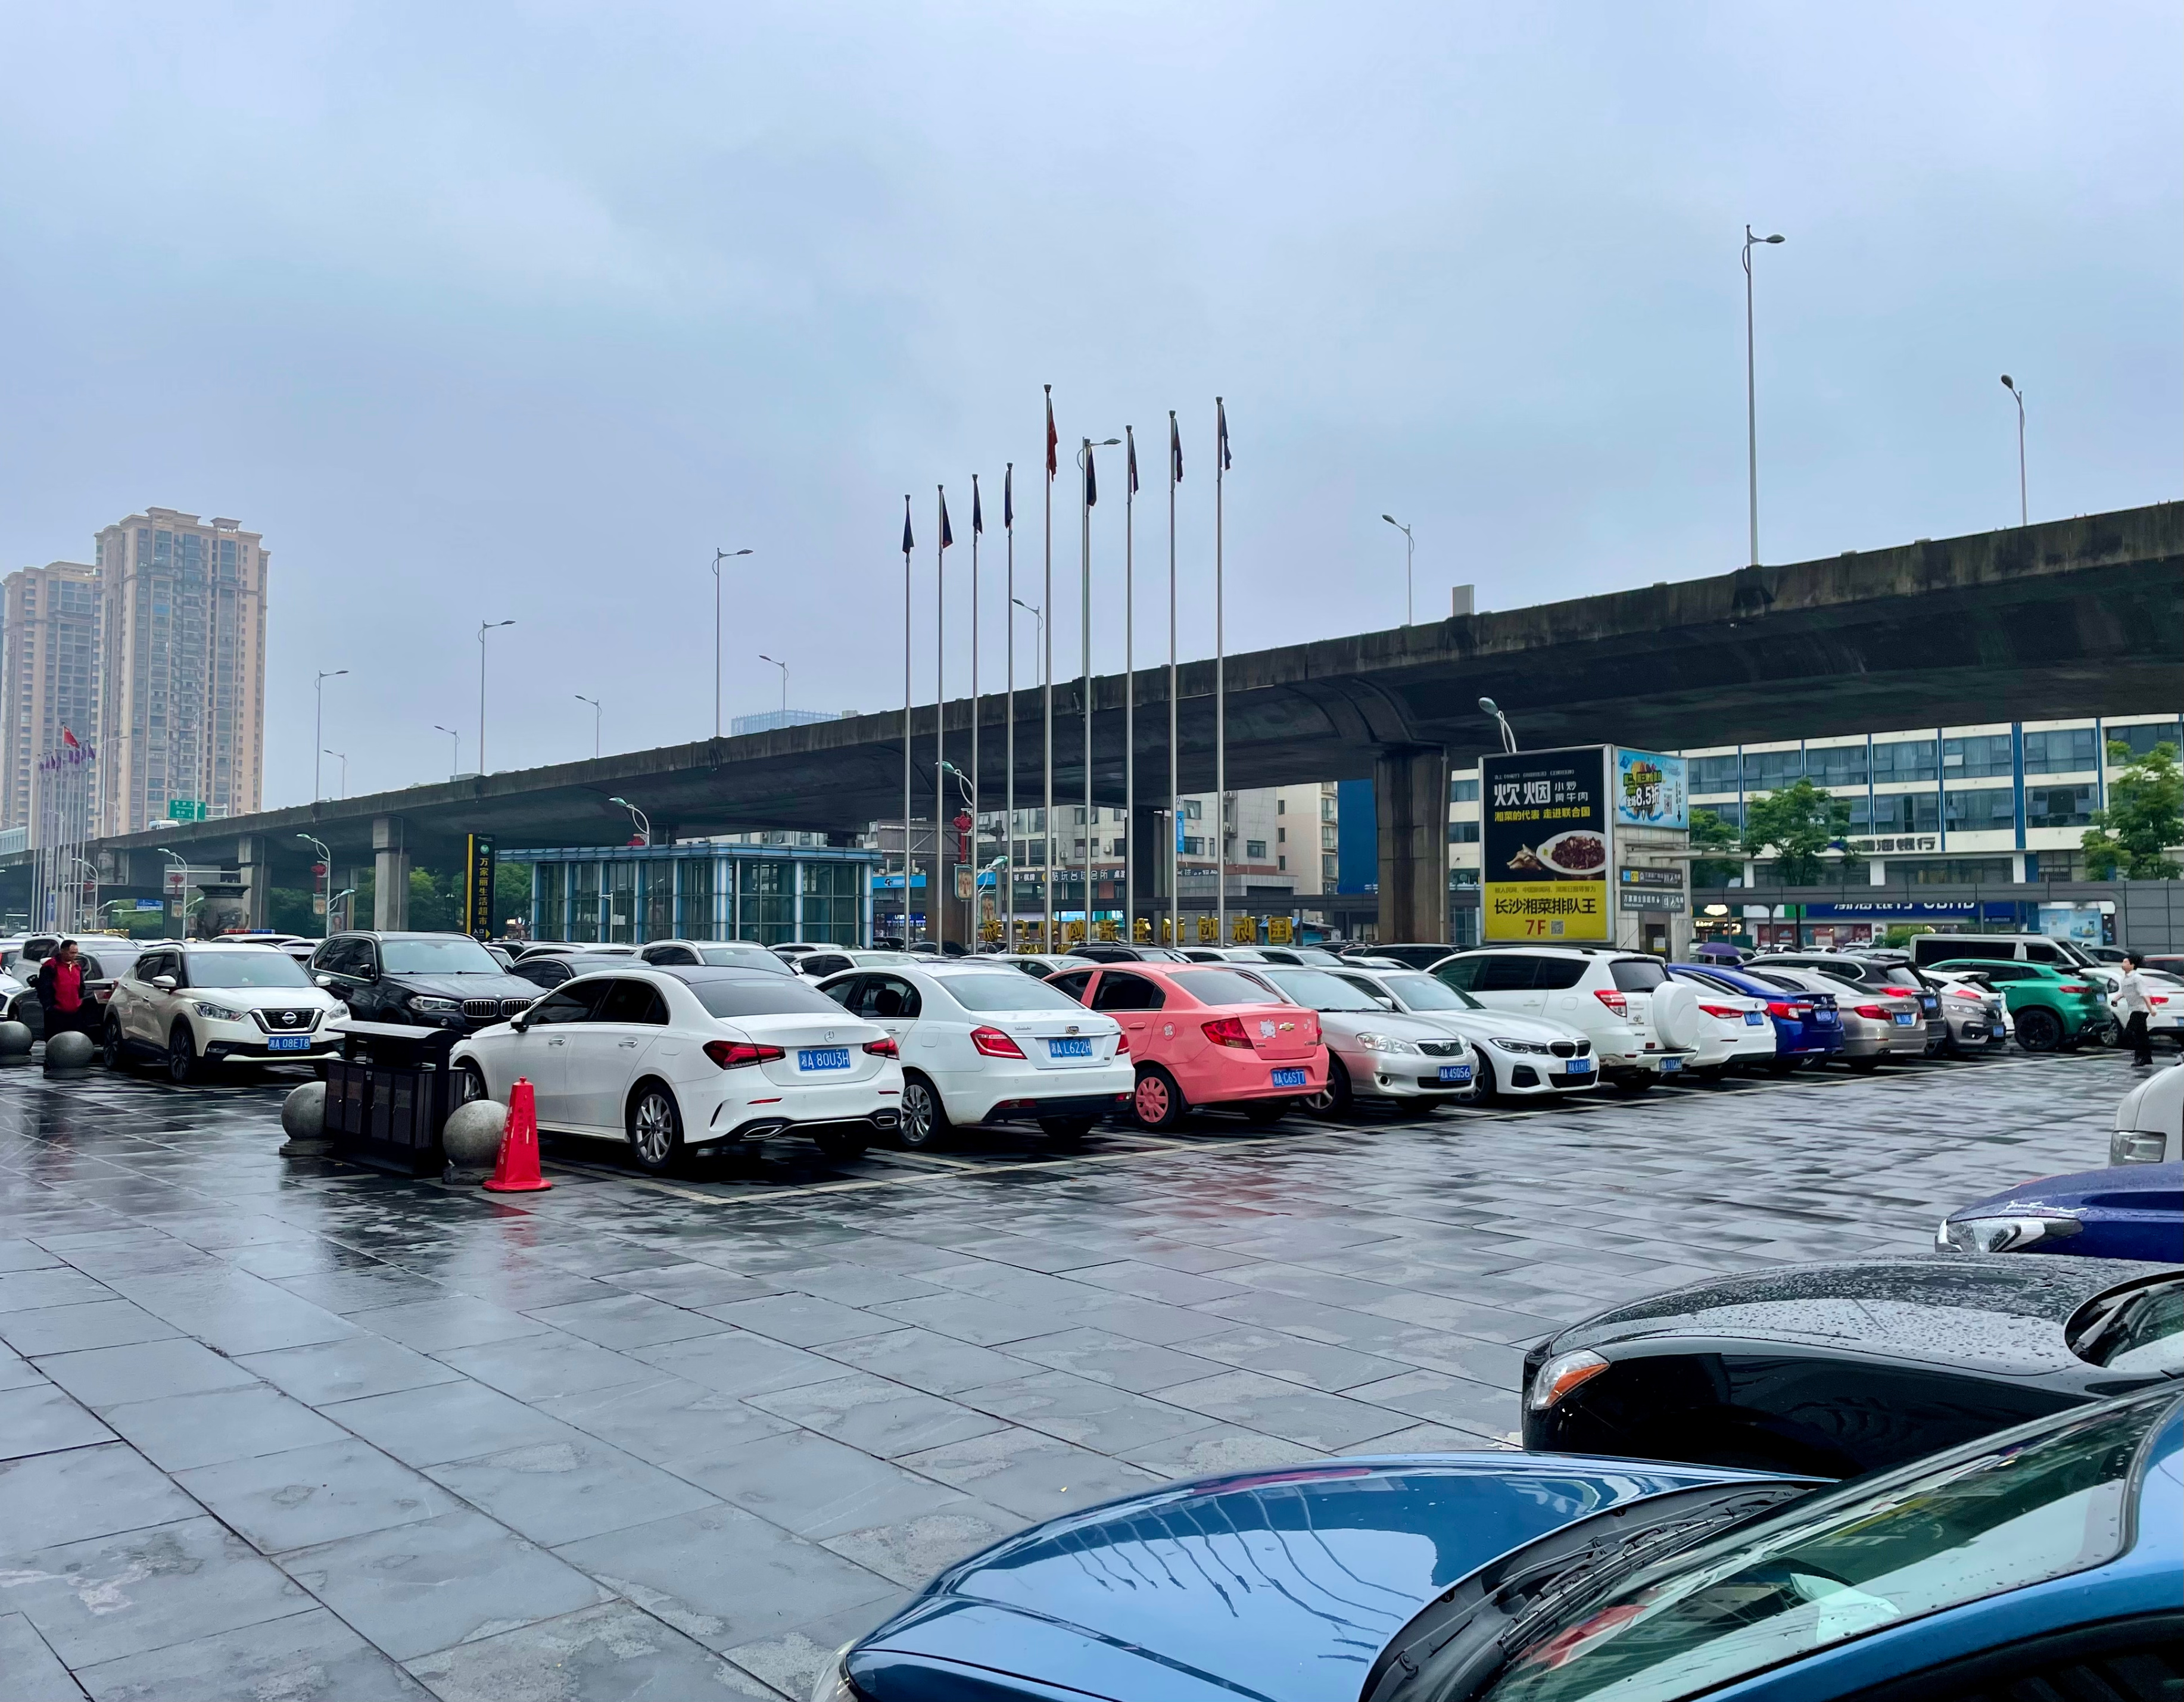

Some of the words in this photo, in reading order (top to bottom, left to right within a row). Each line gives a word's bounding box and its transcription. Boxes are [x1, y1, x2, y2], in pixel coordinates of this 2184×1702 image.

[1494, 780, 1551, 806] 炊烟
[1555, 781, 1577, 791] 小炒
[1555, 791, 1588, 803] 黄牛肉
[1494, 809, 1540, 822] 湘菜的代表
[1543, 806, 1590, 819] 走进联合国
[478, 858, 489, 925] 万家丽生活超市
[1494, 897, 1597, 915] 长沙湘菜排队王
[1525, 919, 1546, 935] 7F
